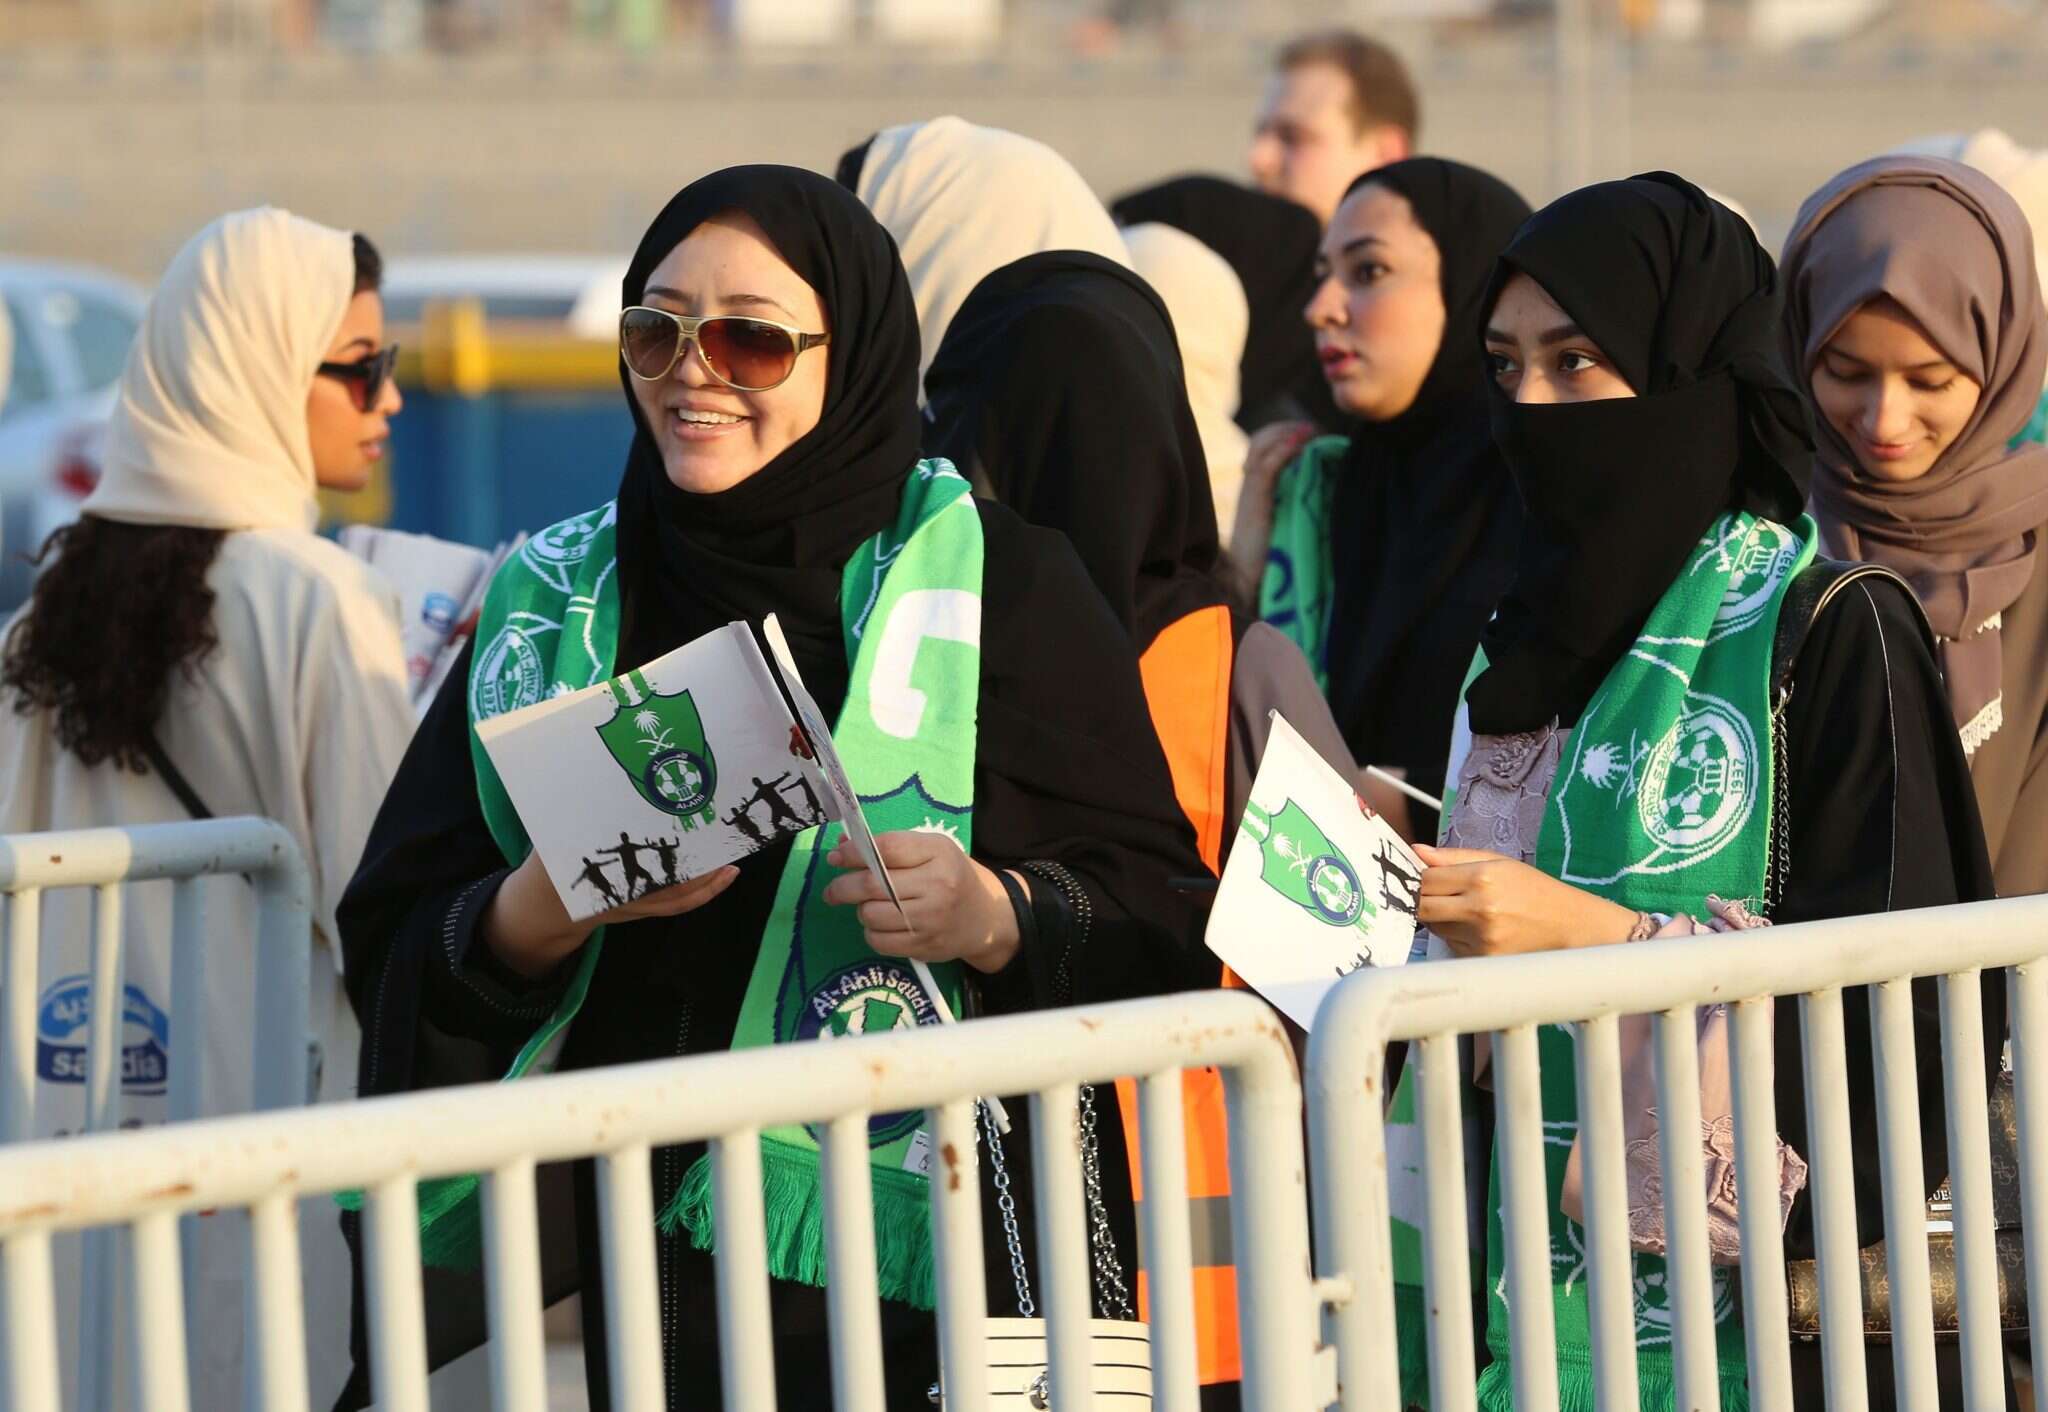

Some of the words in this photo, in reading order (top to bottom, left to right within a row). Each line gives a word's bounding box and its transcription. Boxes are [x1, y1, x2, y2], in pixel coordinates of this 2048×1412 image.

[1776, 549, 1797, 579] 1937
[484, 680, 497, 713] 1937
[1731, 757, 1745, 796] 1937
[885, 969, 930, 1016] Saudi
[51, 1051, 162, 1078] sadia
